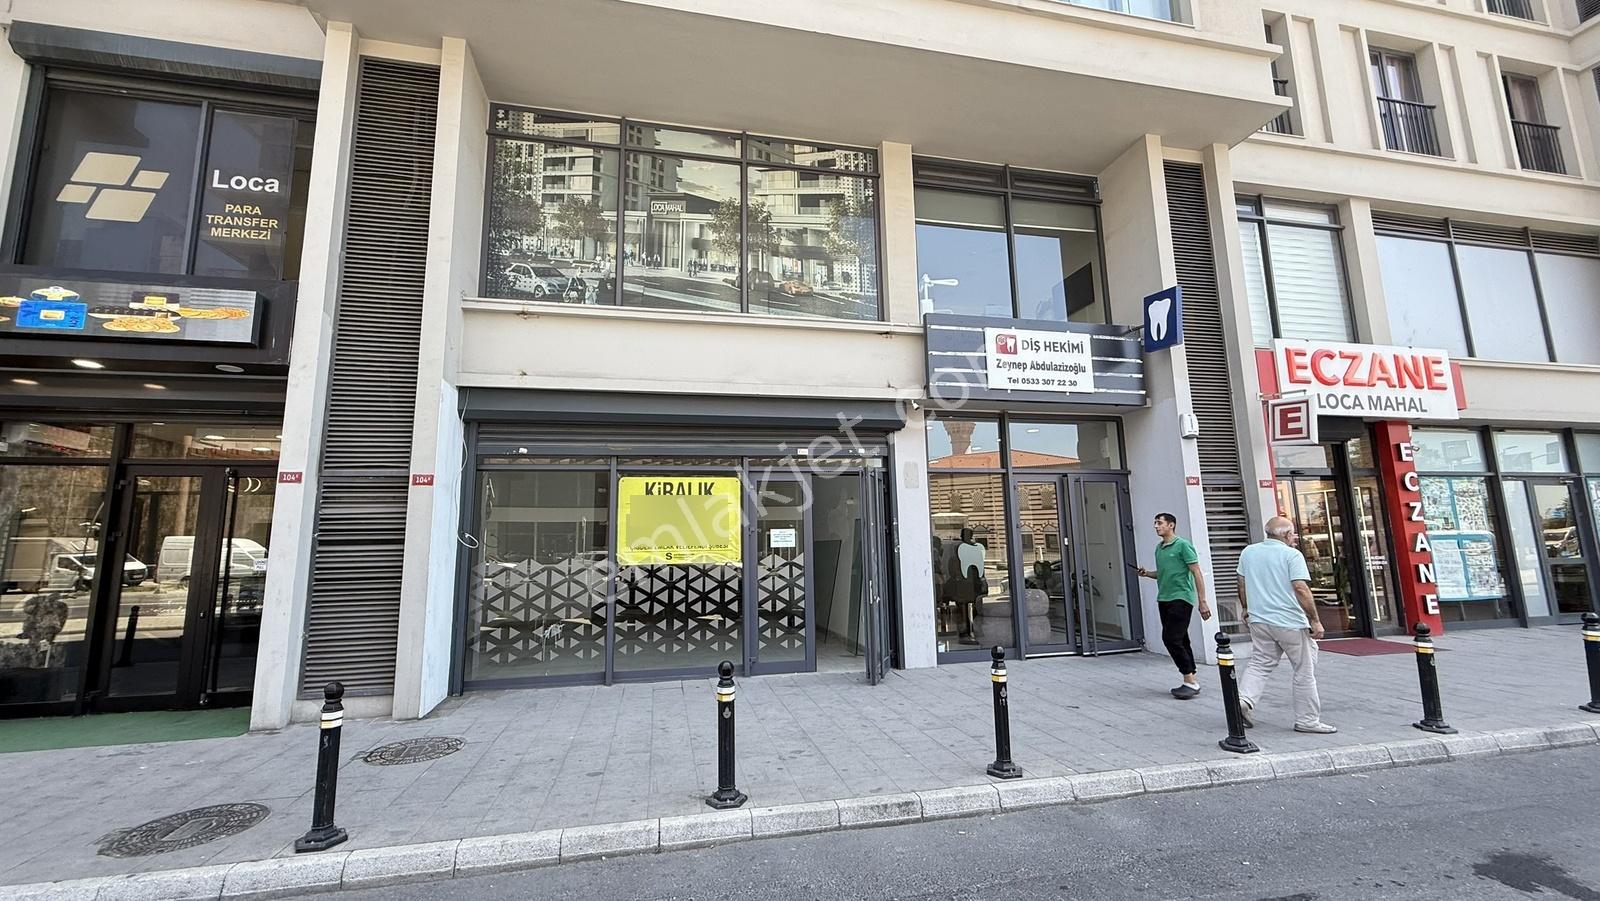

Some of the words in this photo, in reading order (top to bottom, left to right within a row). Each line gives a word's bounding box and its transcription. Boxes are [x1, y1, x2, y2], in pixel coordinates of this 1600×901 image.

[212, 169, 280, 193] Loca
[225, 203, 262, 216] PARA
[205, 214, 279, 229] TRANSFER
[210, 227, 271, 240] MERKEZİ
[1021, 337, 1041, 353] DİŞ
[1044, 339, 1084, 354] HEKİMİ
[995, 358, 1028, 373] Zeynep
[1030, 360, 1087, 375] Abdulazizoğlu
[1284, 346, 1448, 391] ECZANE
[1007, 377, 1020, 385] Tel
[1021, 377, 1040, 386] 0533
[1042, 378, 1055, 387] 307
[1057, 379, 1067, 387] 22
[1316, 392, 1365, 411] LOCA
[1367, 394, 1428, 413] MAHAL
[1279, 406, 1303, 436] E
[1399, 442, 1440, 615] ECZANE
